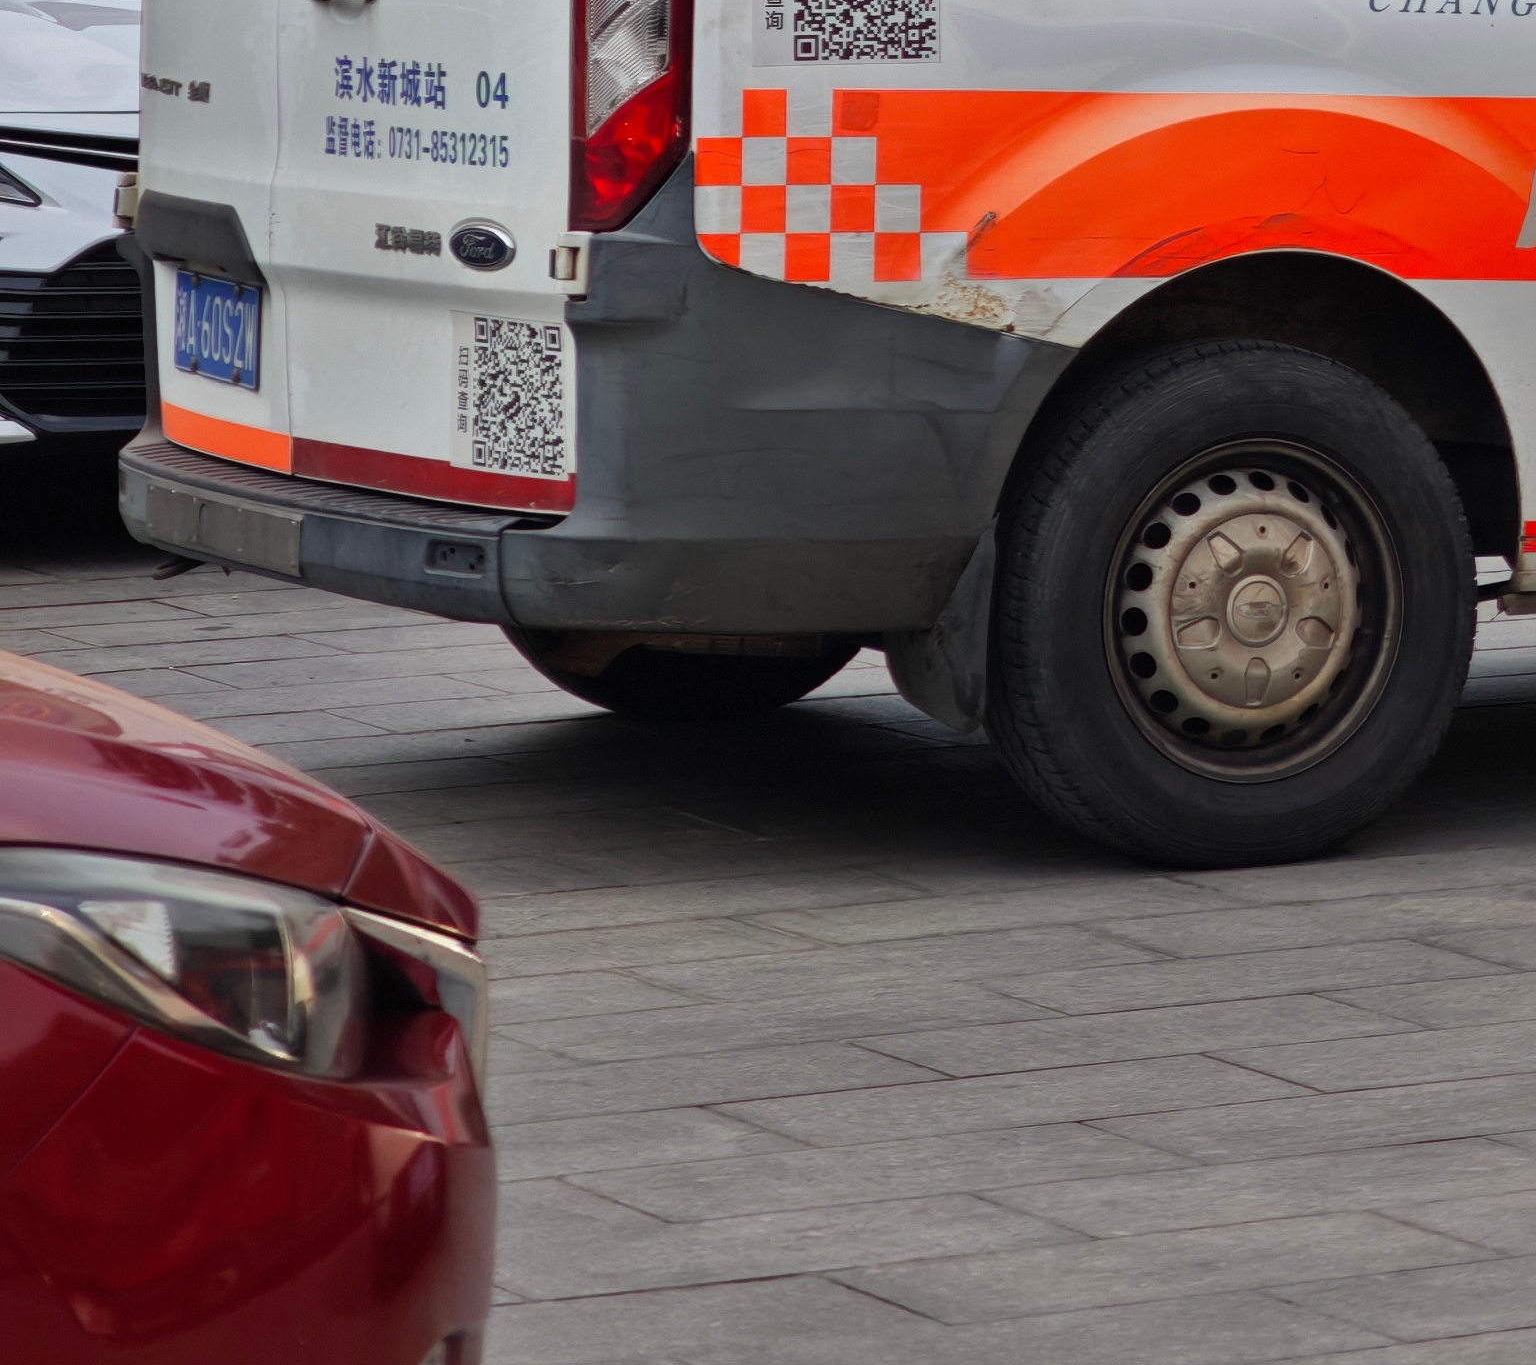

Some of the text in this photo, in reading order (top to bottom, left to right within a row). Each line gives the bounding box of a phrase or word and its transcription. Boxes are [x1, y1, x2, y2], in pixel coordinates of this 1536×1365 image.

[334, 55, 509, 110] 滨水新城站 04
[459, 234, 496, 259] Ford
